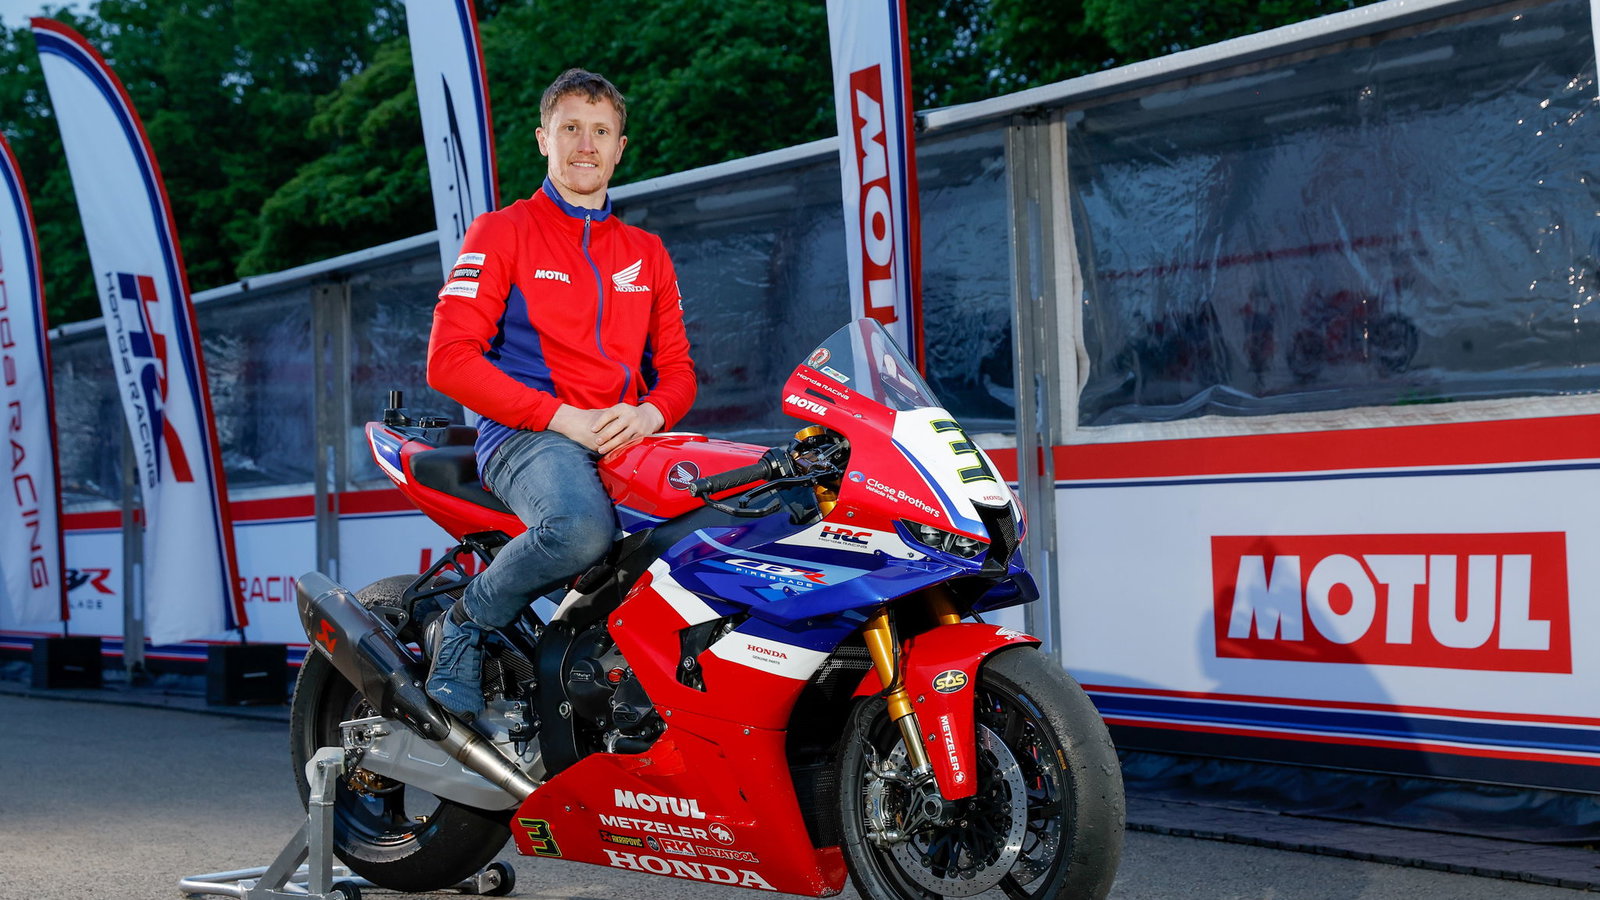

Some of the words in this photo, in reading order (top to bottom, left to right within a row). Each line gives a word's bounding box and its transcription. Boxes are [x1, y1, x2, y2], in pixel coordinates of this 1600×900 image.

[534, 269, 571, 284] MOTUL
[796, 372, 822, 387] Honda
[821, 384, 850, 400] RACING
[785, 394, 828, 416] MOTUL
[129, 381, 156, 489] RACING
[930, 419, 996, 484] 3
[9, 401, 49, 590] RACING
[866, 478, 896, 495] Close
[897, 490, 940, 518] Brothers
[820, 526, 873, 545] HRC
[735, 567, 813, 587] FIREBLADE
[1227, 553, 1551, 651] MOTUL
[747, 644, 788, 660] HONDA
[939, 715, 961, 772] METZELER
[614, 788, 706, 819] MOTUL
[517, 817, 563, 858] 3
[599, 814, 710, 841] METZELER
[664, 839, 694, 853] RK
[696, 845, 760, 864] DATATOOL
[602, 848, 778, 891] HONDA
